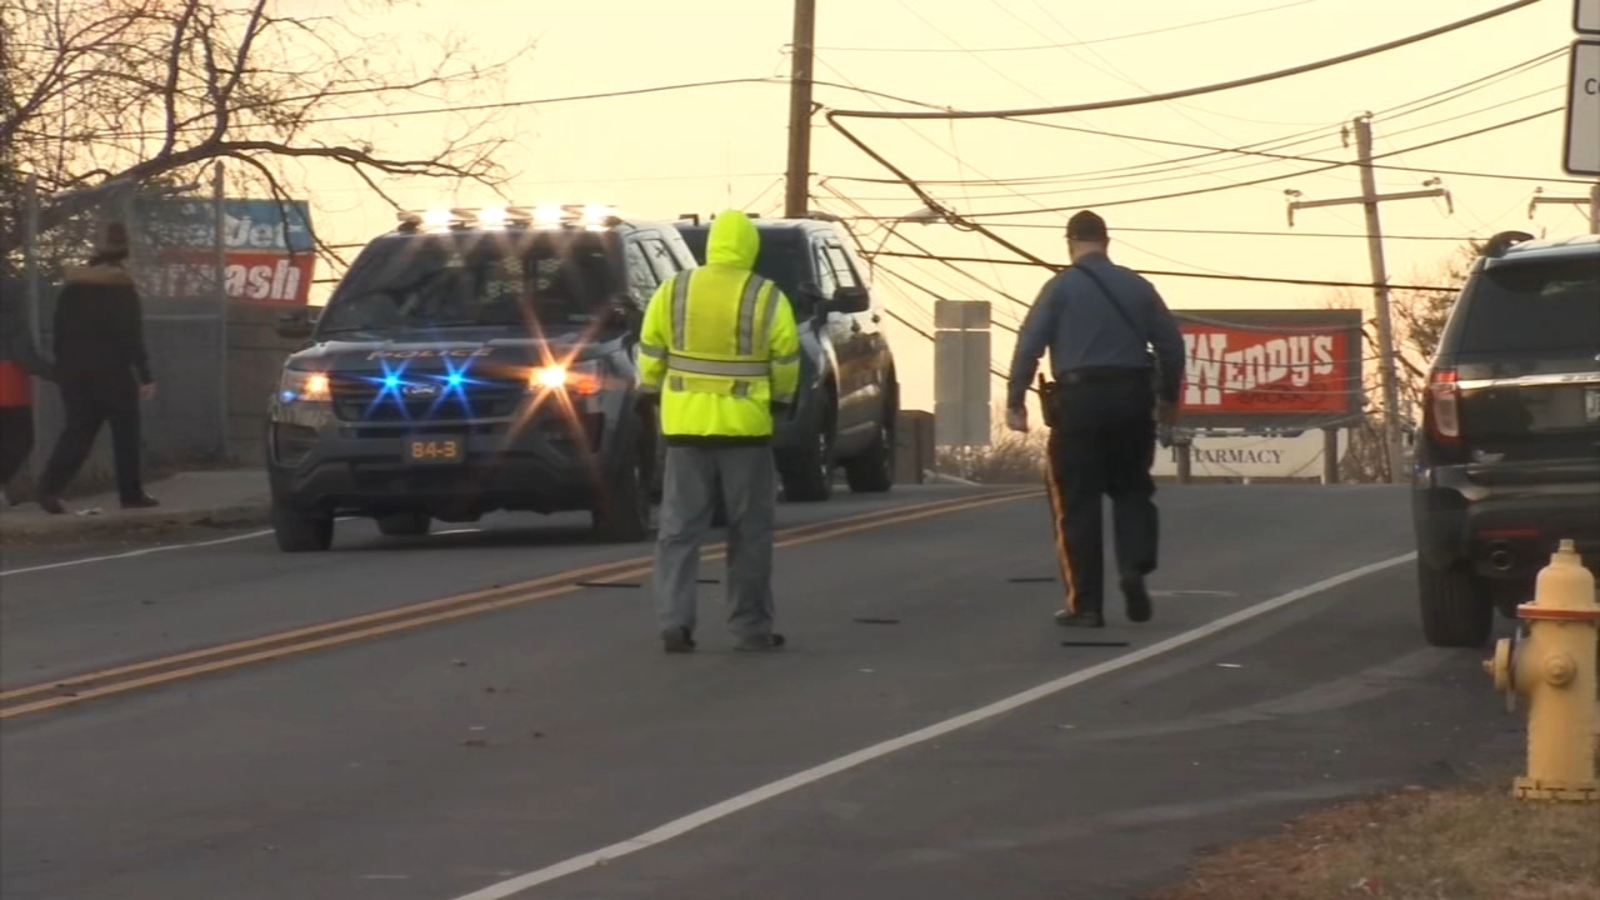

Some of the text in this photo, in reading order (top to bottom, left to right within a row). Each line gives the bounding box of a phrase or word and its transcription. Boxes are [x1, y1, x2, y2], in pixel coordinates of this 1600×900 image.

[1585, 78, 1600, 95] C
[366, 348, 494, 361] POLICE
[1172, 449, 1283, 463] ARMACY
